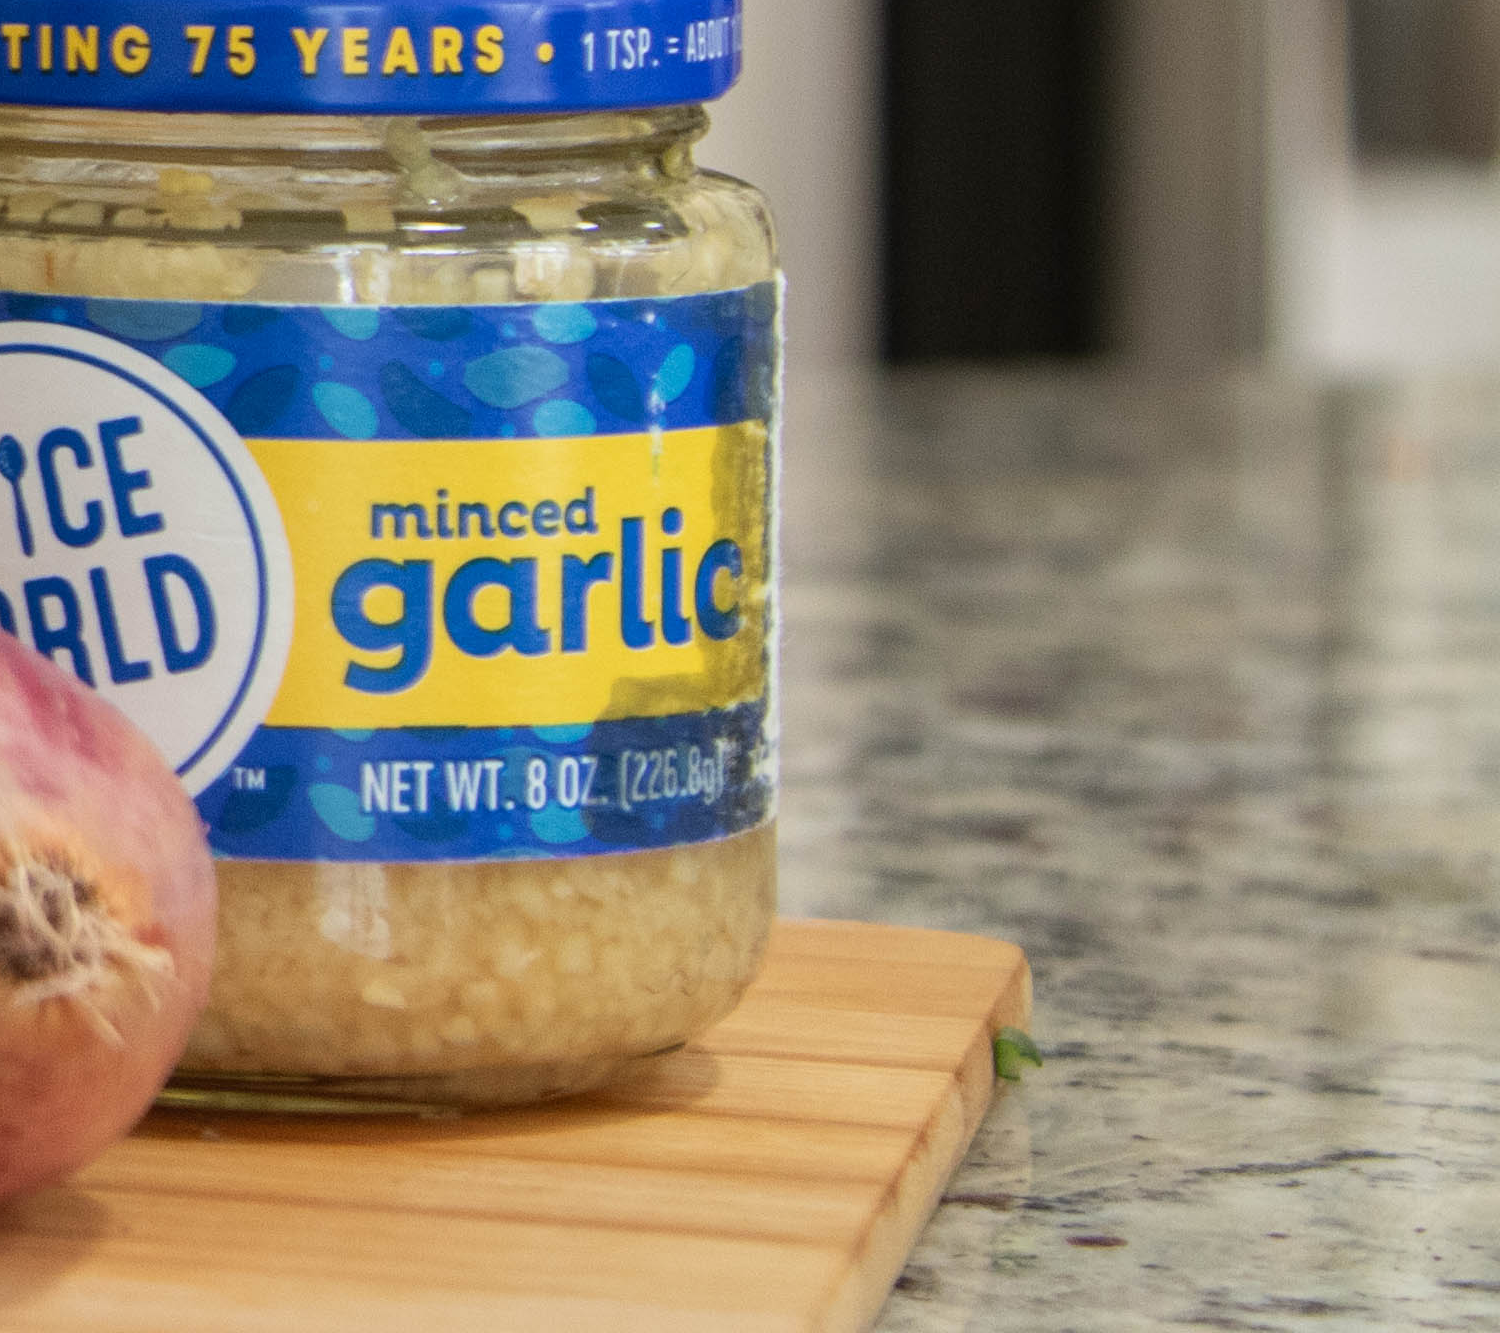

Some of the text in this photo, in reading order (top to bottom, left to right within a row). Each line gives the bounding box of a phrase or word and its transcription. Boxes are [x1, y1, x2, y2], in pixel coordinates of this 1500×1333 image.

[185, 24, 258, 77] 75
[293, 22, 507, 77] YEARS
[582, 31, 595, 72] 1
[605, 26, 661, 71] TSP.
[369, 485, 599, 540] minced
[329, 507, 744, 696] garlic
[362, 760, 435, 814] NET
[444, 758, 517, 811] WT.
[524, 757, 549, 811] 8
[556, 755, 609, 808] OZ.
